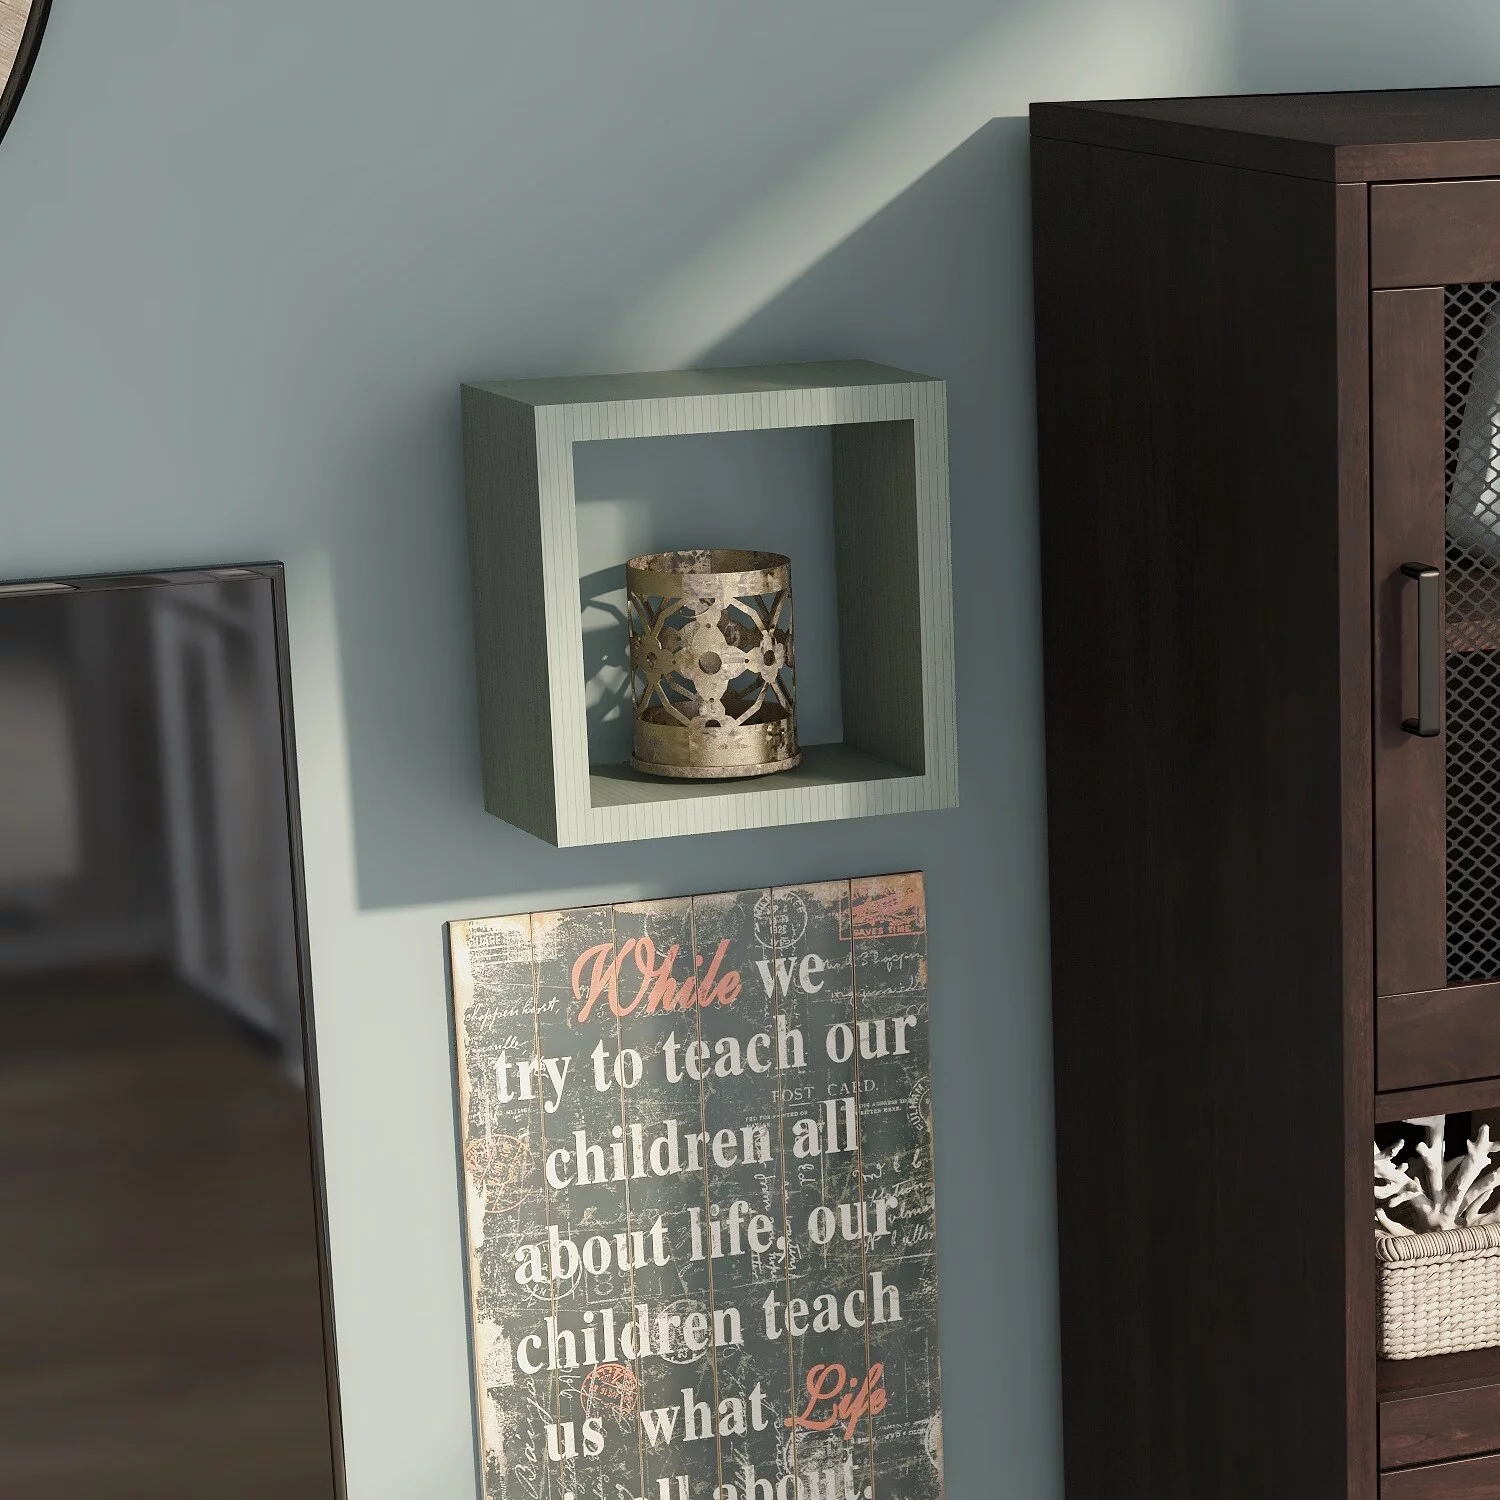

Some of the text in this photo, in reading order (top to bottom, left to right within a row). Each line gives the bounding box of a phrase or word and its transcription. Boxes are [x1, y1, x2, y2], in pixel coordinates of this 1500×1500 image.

[571, 937, 825, 1024] While we
[495, 1013, 919, 1114] try to teach our
[772, 1086, 815, 1103] POST
[545, 1118, 773, 1190] children
[792, 1097, 858, 1159] all
[514, 1215, 671, 1285] about
[687, 1198, 788, 1264] life,
[808, 1196, 899, 1245] our
[516, 1270, 903, 1375] children teach
[544, 1415, 605, 1462] us
[639, 1381, 769, 1447] what
[784, 1362, 888, 1441] Life
